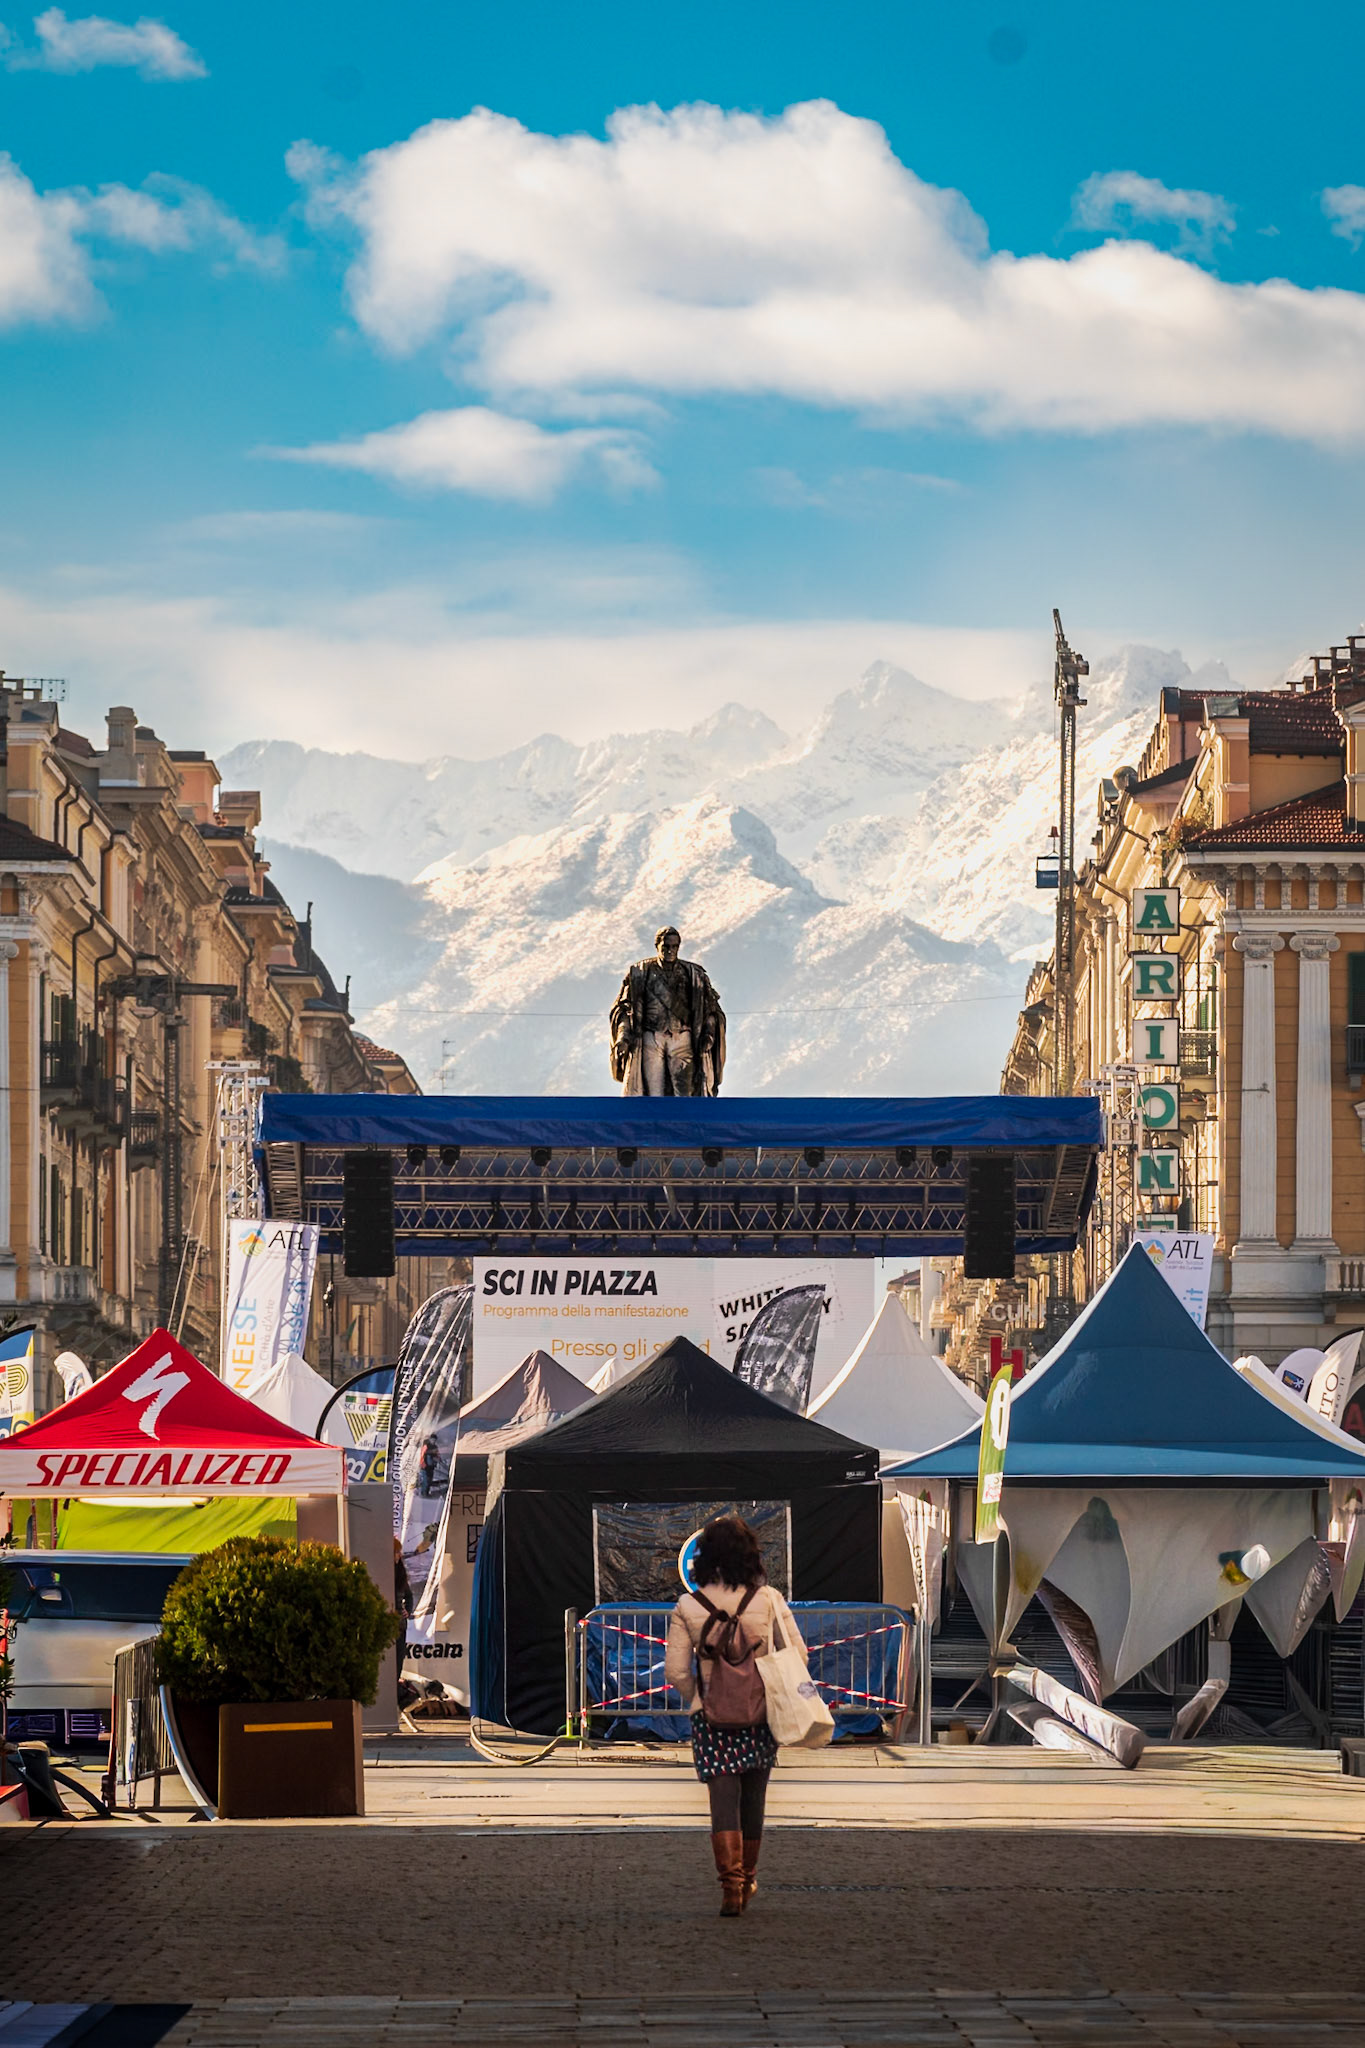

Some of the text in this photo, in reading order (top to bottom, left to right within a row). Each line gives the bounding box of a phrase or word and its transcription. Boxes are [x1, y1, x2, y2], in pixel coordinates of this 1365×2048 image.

[268, 1229, 310, 1251] ATL
[1166, 1239, 1204, 1260] ATL
[482, 1269, 658, 1296] SCI IN PIAZZA
[483, 1303, 689, 1320] Programma della manifestazione
[551, 1338, 618, 1357] Presso
[622, 1337, 648, 1361] gli
[392, 1416, 407, 1480] OUTDOOR
[26, 1453, 292, 1487] SPECIALIZED
